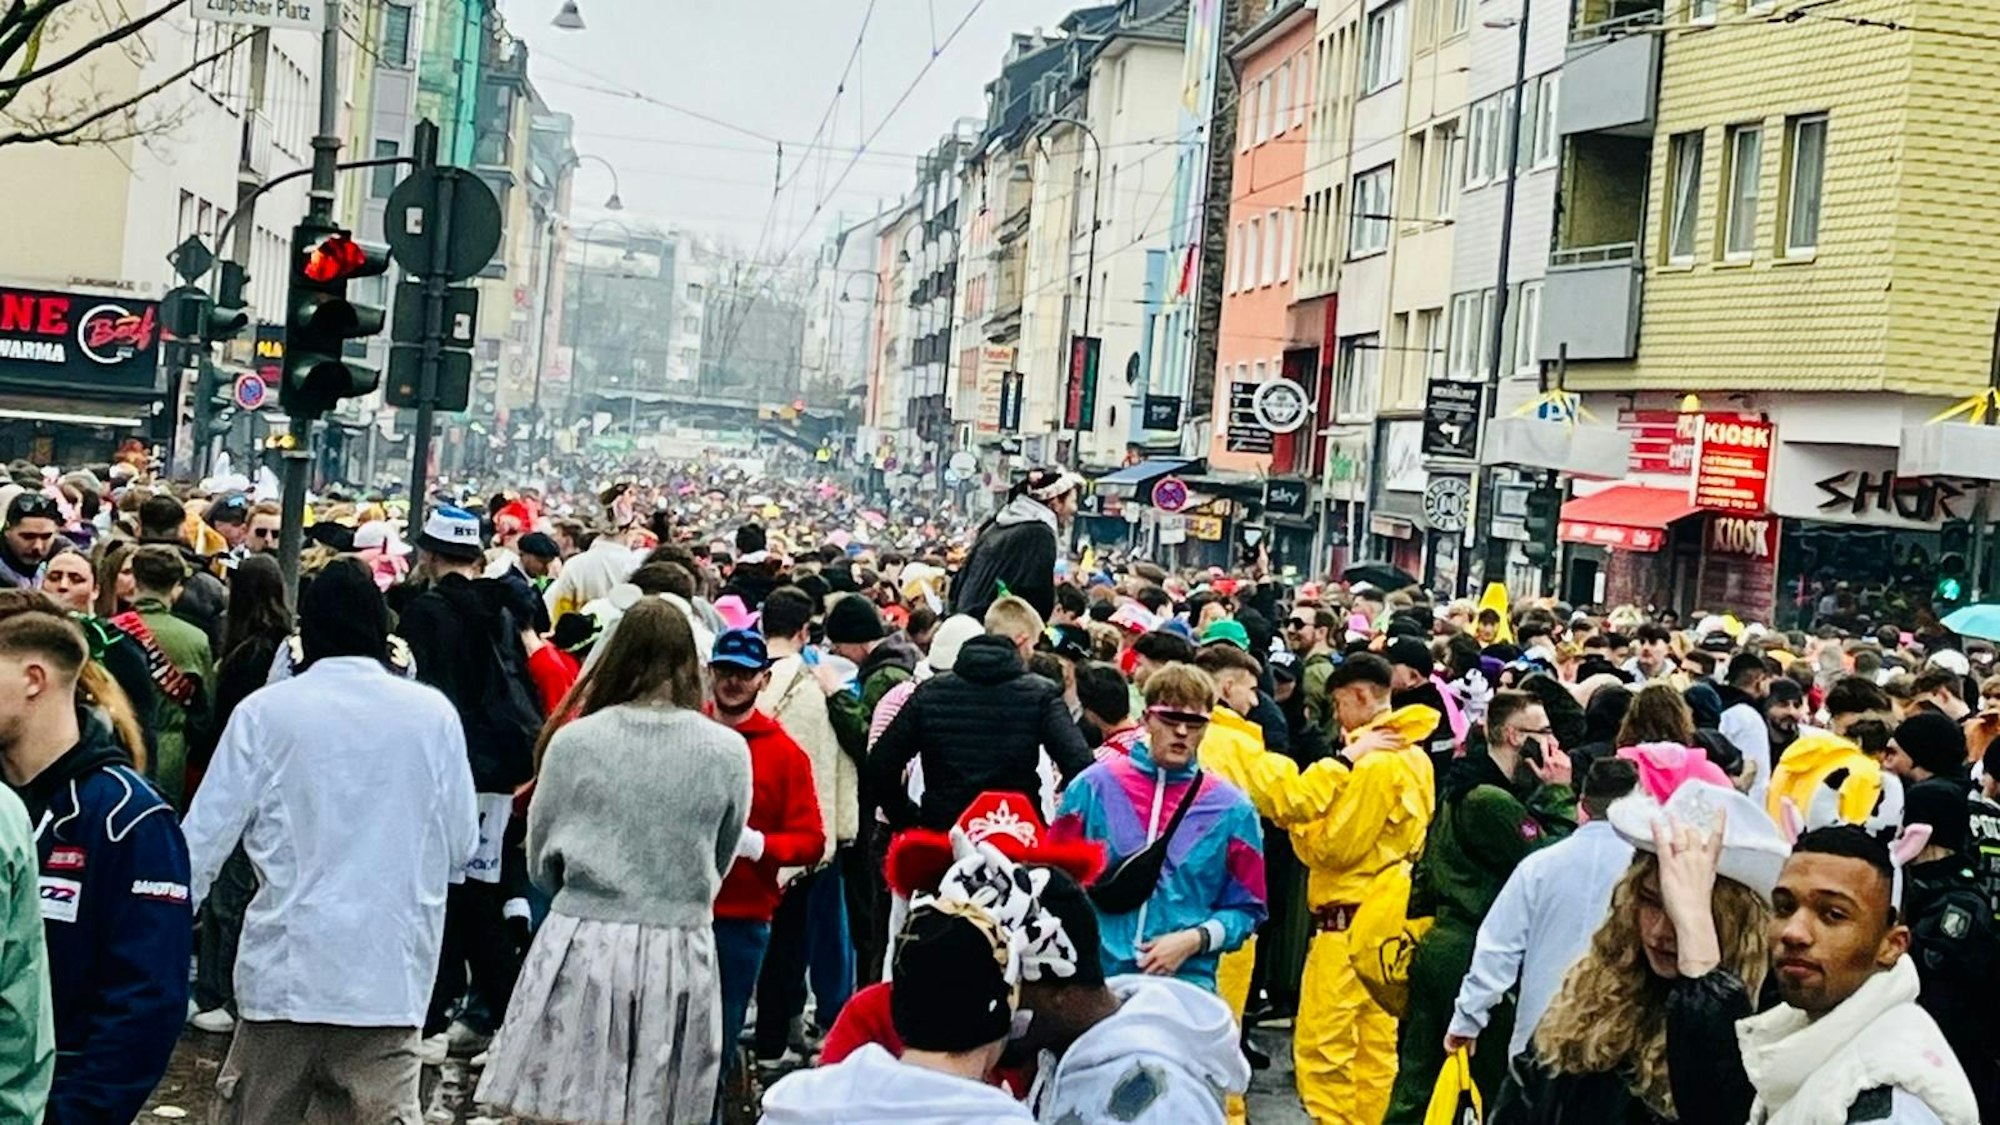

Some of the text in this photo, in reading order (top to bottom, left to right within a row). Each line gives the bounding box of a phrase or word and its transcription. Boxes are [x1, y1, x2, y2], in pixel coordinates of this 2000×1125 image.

[1704, 422, 1769, 448] KIOSK
[1270, 487, 1300, 505] sky
[1712, 517, 1769, 556] KIOSK
